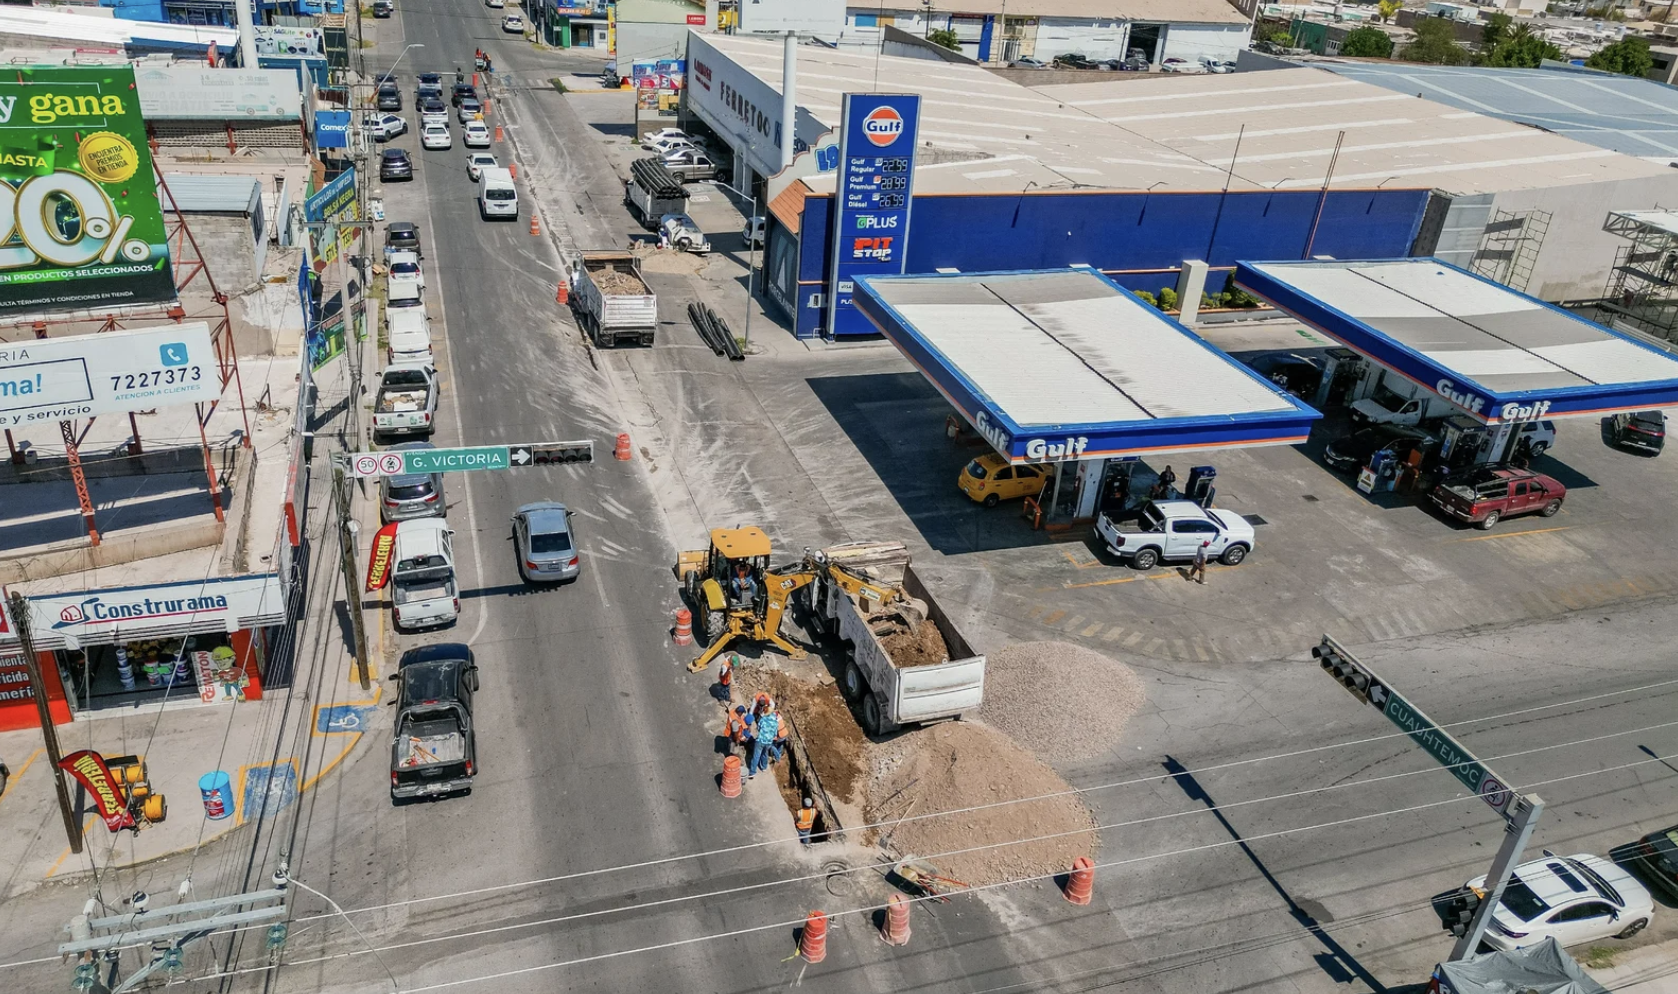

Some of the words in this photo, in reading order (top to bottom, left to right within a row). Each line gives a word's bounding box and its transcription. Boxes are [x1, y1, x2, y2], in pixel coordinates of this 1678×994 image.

[29, 93, 125, 124] gana
[320, 123, 347, 132] Comex
[866, 120, 902, 133] Gulf
[88, 145, 123, 160] ENCUENTRA
[96, 153, 123, 166] PREMIOS
[106, 160, 129, 171] TIENDA
[851, 166, 875, 174] Regular
[853, 237, 893, 249] PIT
[853, 249, 892, 258] STOP
[13, 269, 74, 281] PRODUCTOS
[75, 264, 154, 277] SELECCIONADOS
[56, 294, 101, 303] CONDICIONES
[111, 290, 134, 299] TIENDA
[111, 366, 201, 391] 7227373
[115, 389, 155, 400] ATENCION
[163, 384, 201, 395] CLIENTES
[1436, 379, 1485, 413] Gulf
[12, 415, 21, 425] y
[27, 405, 91, 421] servicio
[1501, 400, 1552, 422] Gulf
[975, 410, 1010, 450] Gulf
[1027, 436, 1089, 459] Gulf
[360, 460, 374, 469] 50
[412, 457, 428, 468] G.
[432, 452, 501, 467] VICTORIA
[781, 579, 793, 590] CAT
[93, 594, 228, 620] Construrama
[0, 670, 29, 684] icida
[1390, 702, 1479, 783] CUAUHTEMOC
